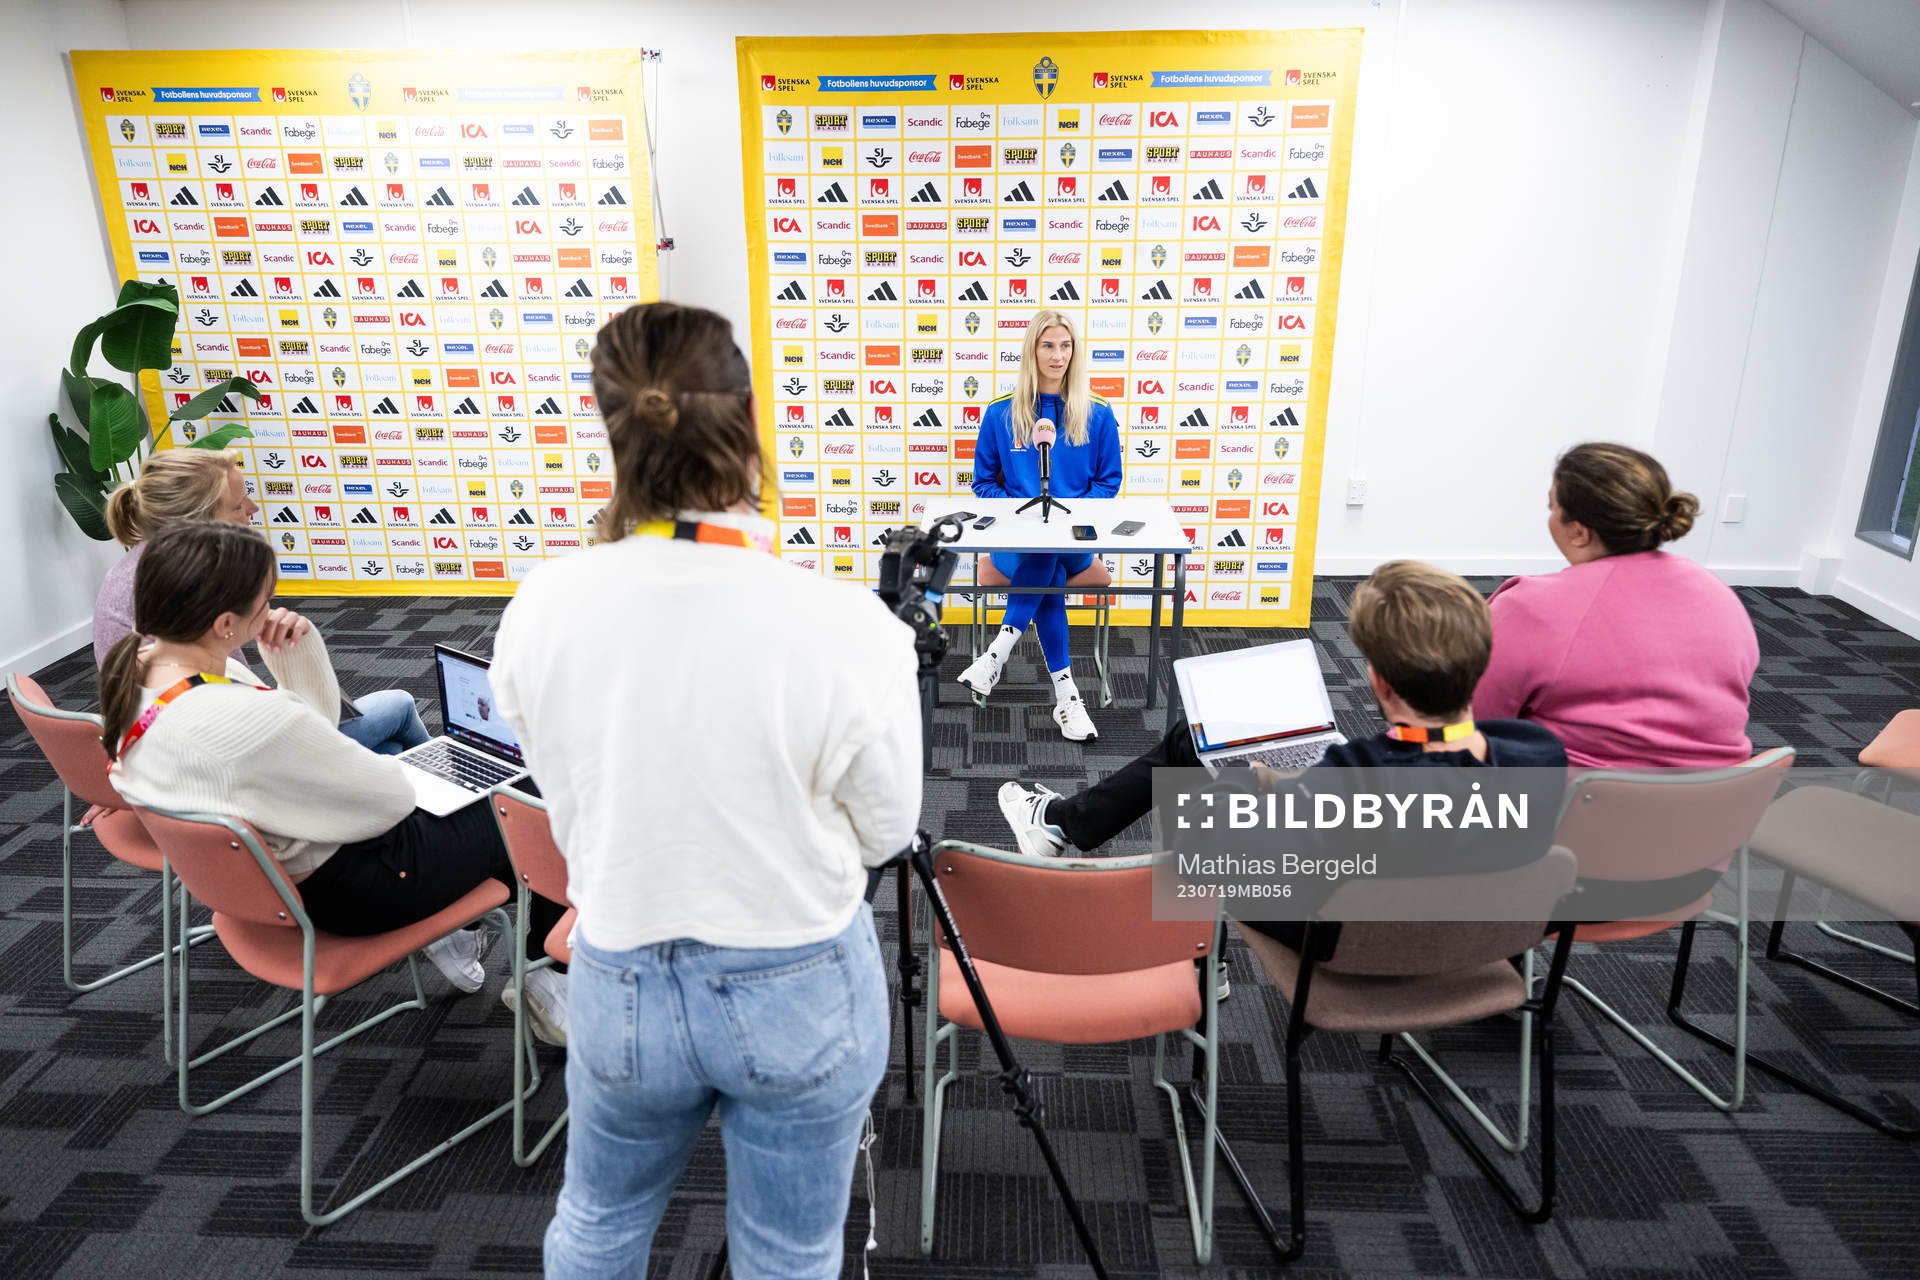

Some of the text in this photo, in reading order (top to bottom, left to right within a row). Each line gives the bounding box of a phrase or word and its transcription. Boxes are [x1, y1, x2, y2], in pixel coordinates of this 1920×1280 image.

[966, 76, 1000, 84] SVENSKA
[1160, 73, 1263, 85] Fotbollens huvudsponsor
[1303, 71, 1337, 79] SVENSKA
[777, 78, 811, 86] SVENSKA
[827, 78, 928, 90] Fotbollens huvudsponsor
[1303, 78, 1320, 86] SPEL
[161, 91, 252, 100] Fotbollens huvudsponsor
[556, 120, 566, 129] SJ
[815, 115, 848, 127] SPORT
[907, 117, 943, 127] Scandic
[955, 117, 990, 130] Fabege
[1150, 111, 1179, 128] ICA
[460, 124, 488, 138] ICA
[874, 148, 884, 158] SJ
[1146, 147, 1180, 158] SPORT
[1241, 149, 1277, 158] Scandic
[333, 157, 363, 168] SPORT
[463, 157, 493, 168] SPORT
[549, 159, 581, 168] Scandic
[592, 158, 624, 171] Fabege
[1249, 213, 1260, 223] SJ
[133, 220, 161, 234] ICA
[173, 222, 205, 231] Scandic
[300, 220, 330, 231] SPORT
[384, 223, 416, 232] Scandic
[427, 222, 459, 235] Fabege
[516, 220, 542, 235] ICA
[773, 217, 802, 233] ICA
[816, 221, 851, 230] Scandic
[906, 222, 947, 230] BAUHAUS
[956, 218, 989, 229] SPORT
[1096, 220, 1130, 233] Fabege
[1193, 215, 1221, 232] ICA
[357, 249, 366, 258] SJ
[865, 251, 897, 262] SPORT
[910, 254, 944, 263] Scandic
[1184, 253, 1226, 261] BAUHAUS
[180, 253, 211, 266] Fabege
[263, 255, 295, 263] Scandic
[601, 253, 632, 266] Fabege
[818, 254, 852, 267] Fabege
[959, 251, 987, 267] ICA
[201, 309, 210, 318] SJ
[832, 314, 841, 323] SJ
[353, 315, 390, 323] BAUHAUS
[400, 313, 426, 326] ICA
[565, 314, 596, 327] Fabege
[1278, 315, 1306, 330] ICA
[1230, 318, 1263, 331] Fabege
[196, 343, 230, 352] Scandic
[280, 341, 308, 351] SPORT
[320, 344, 351, 353] Scandic
[820, 351, 856, 360] Scandic
[955, 352, 989, 361] Scandic
[173, 367, 183, 376] SJ
[204, 369, 233, 380] SPORT
[285, 372, 315, 385] Fabege
[490, 371, 516, 385] ICA
[790, 377, 800, 386] SJ
[823, 379, 854, 390] SPORT
[911, 382, 944, 395] Fabege
[1137, 380, 1164, 394] ICA
[1178, 382, 1215, 391] Scandic
[1270, 383, 1304, 396] Fabege
[292, 429, 328, 437] BAUHAUS
[416, 428, 443, 438] SPORT
[505, 426, 514, 434] SJ
[1143, 439, 1154, 449] SJ
[1221, 445, 1254, 454] Scandic
[301, 455, 327, 468] ICA
[418, 458, 449, 467] Scandic
[915, 472, 941, 485] ICA
[265, 482, 293, 492] SPORT
[393, 482, 401, 490] SJ
[826, 503, 858, 515] Fabege
[870, 501, 900, 511] SPORT
[1263, 502, 1289, 516] ICA
[311, 538, 346, 546] BAUHAUS
[391, 539, 421, 547] Scandic
[433, 537, 458, 549] ICA
[469, 539, 498, 550] Fabege
[545, 539, 580, 547] BAUHAUS
[318, 564, 348, 572] Scandic
[367, 560, 376, 569] SJ
[435, 562, 463, 572] SPORT
[1139, 559, 1148, 569] SJ
[1214, 561, 1244, 571] SPORT
[396, 564, 425, 576] Fabege
